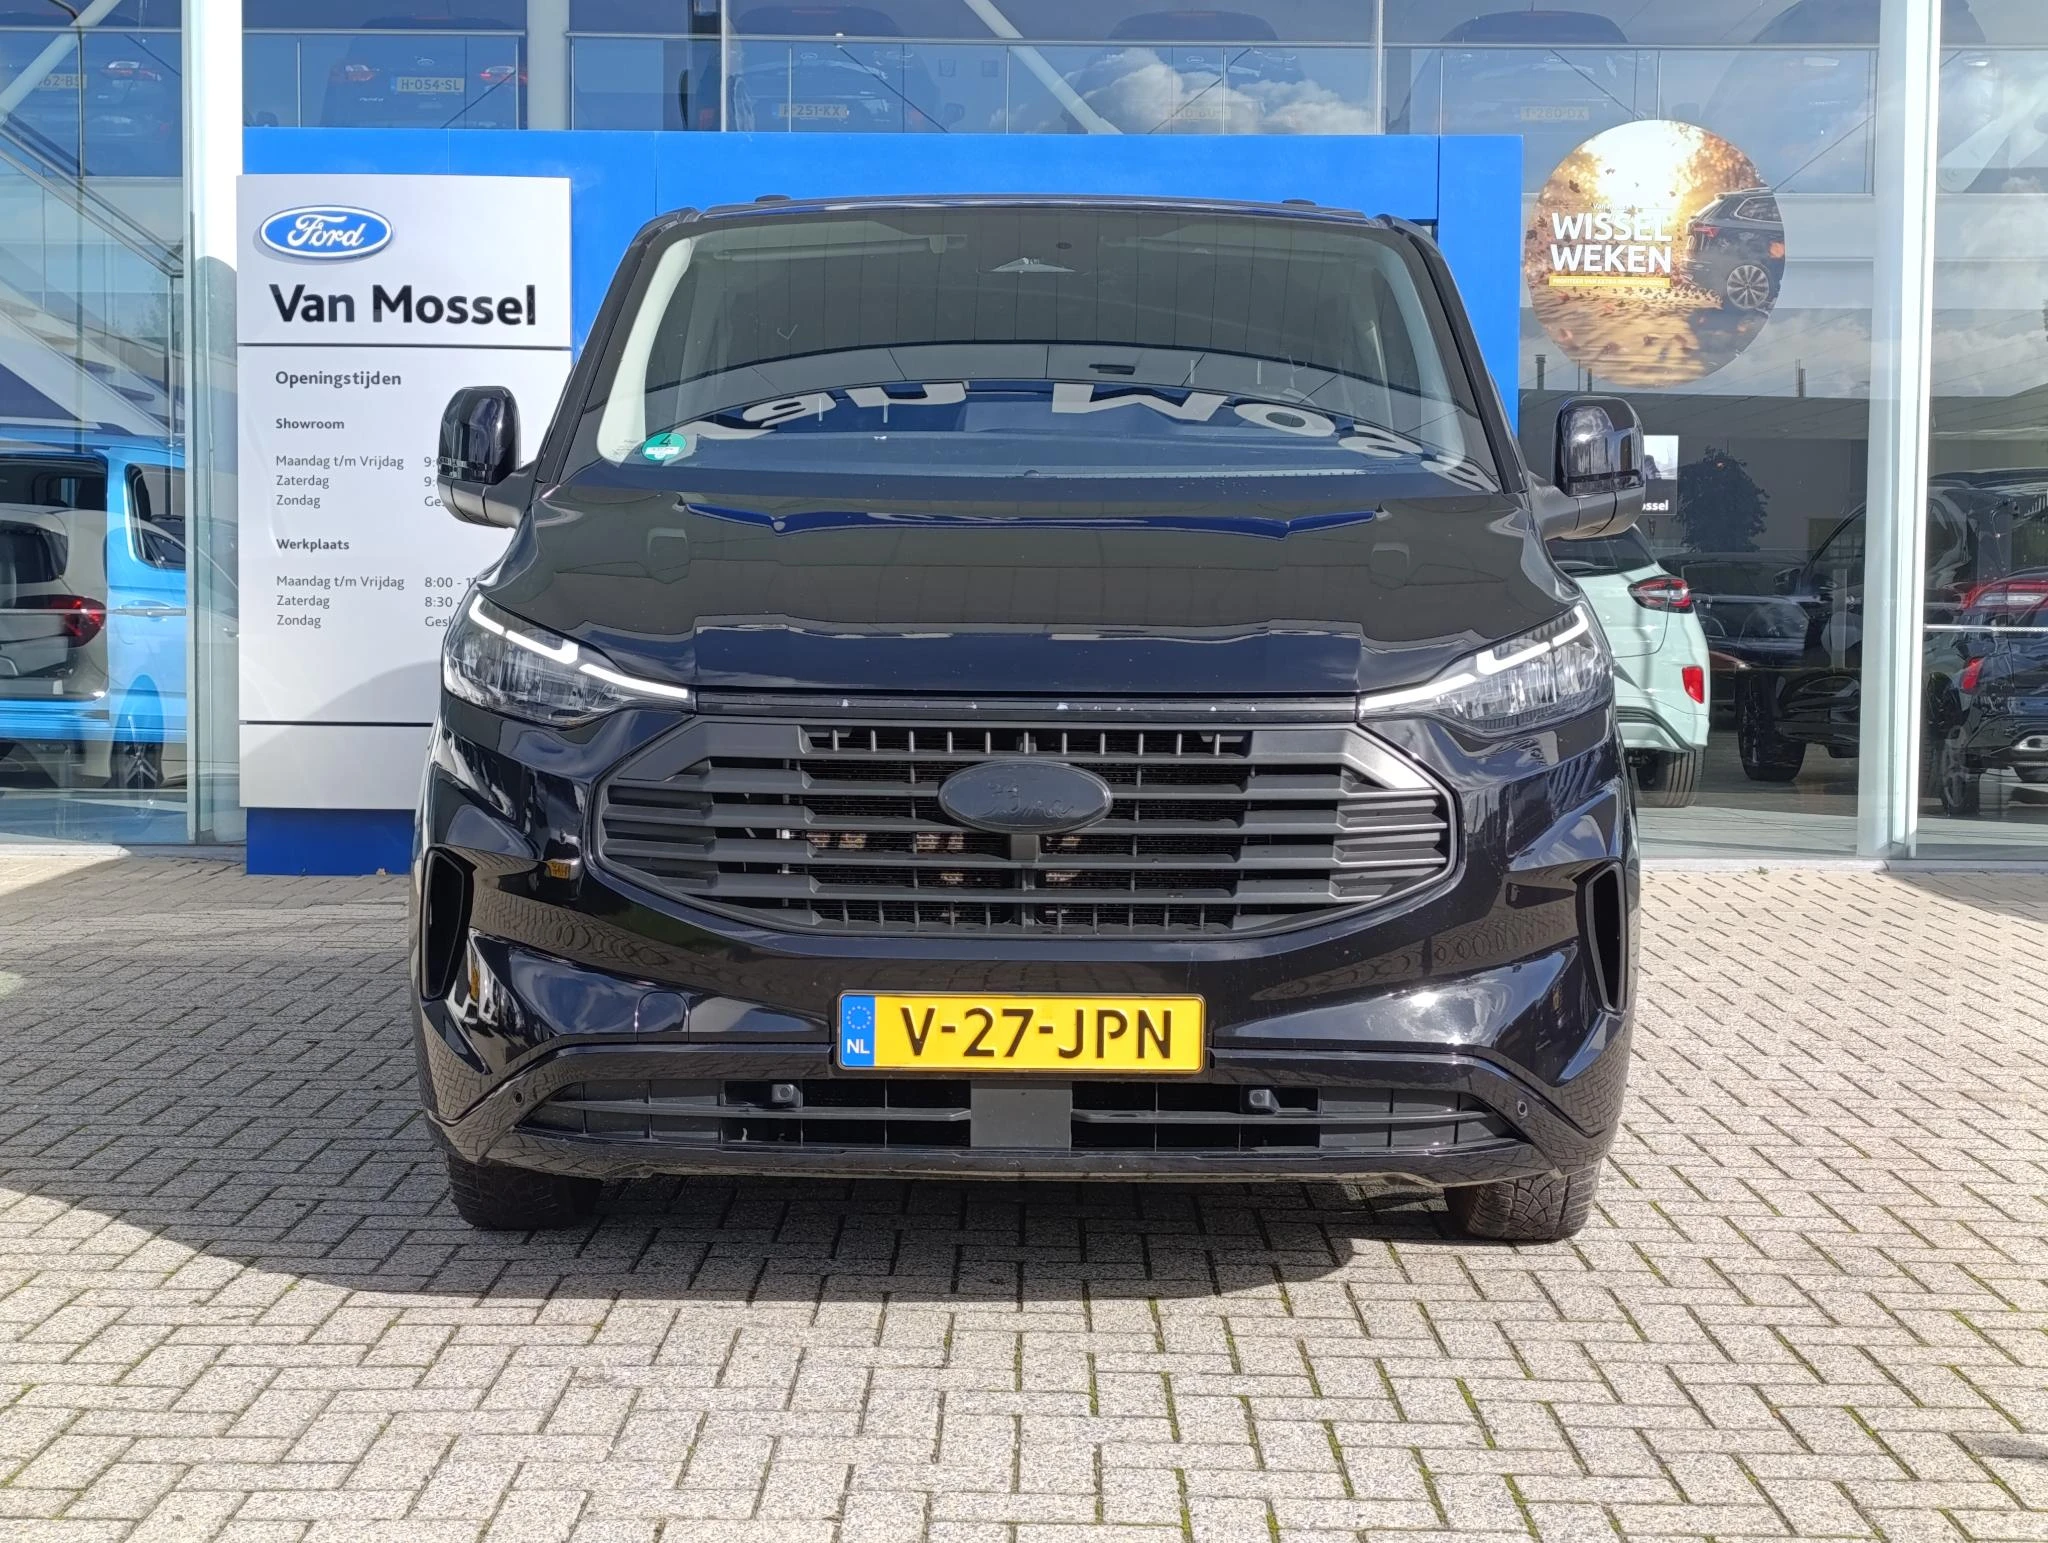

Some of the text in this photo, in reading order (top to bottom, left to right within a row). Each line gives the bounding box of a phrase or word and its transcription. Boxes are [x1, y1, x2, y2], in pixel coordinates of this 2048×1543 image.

[401, 79, 460, 91] H-054-SL
[288, 214, 367, 248] Ford
[1552, 212, 1673, 241] WISSEL
[1550, 244, 1672, 273] WEKEN
[269, 284, 536, 325] Van Mossel
[275, 370, 402, 389] Openingstijden
[275, 418, 345, 429] Showroom
[276, 455, 330, 469] Maandag
[334, 455, 356, 467] t/m
[360, 455, 404, 470] Vrijdag
[276, 475, 330, 489] Zaterdag
[276, 494, 321, 509] Zondag
[276, 538, 350, 553] Werkplaats
[276, 575, 331, 590] Maandag
[334, 575, 357, 588] t/m
[360, 576, 405, 590] Vrijdag
[424, 576, 453, 588] 8:00
[276, 595, 330, 609] Zaterdag
[424, 596, 453, 608] 8:30
[276, 614, 451, 629] Zondag Gesl
[846, 1007, 1172, 1059] NL V-27-JPN
